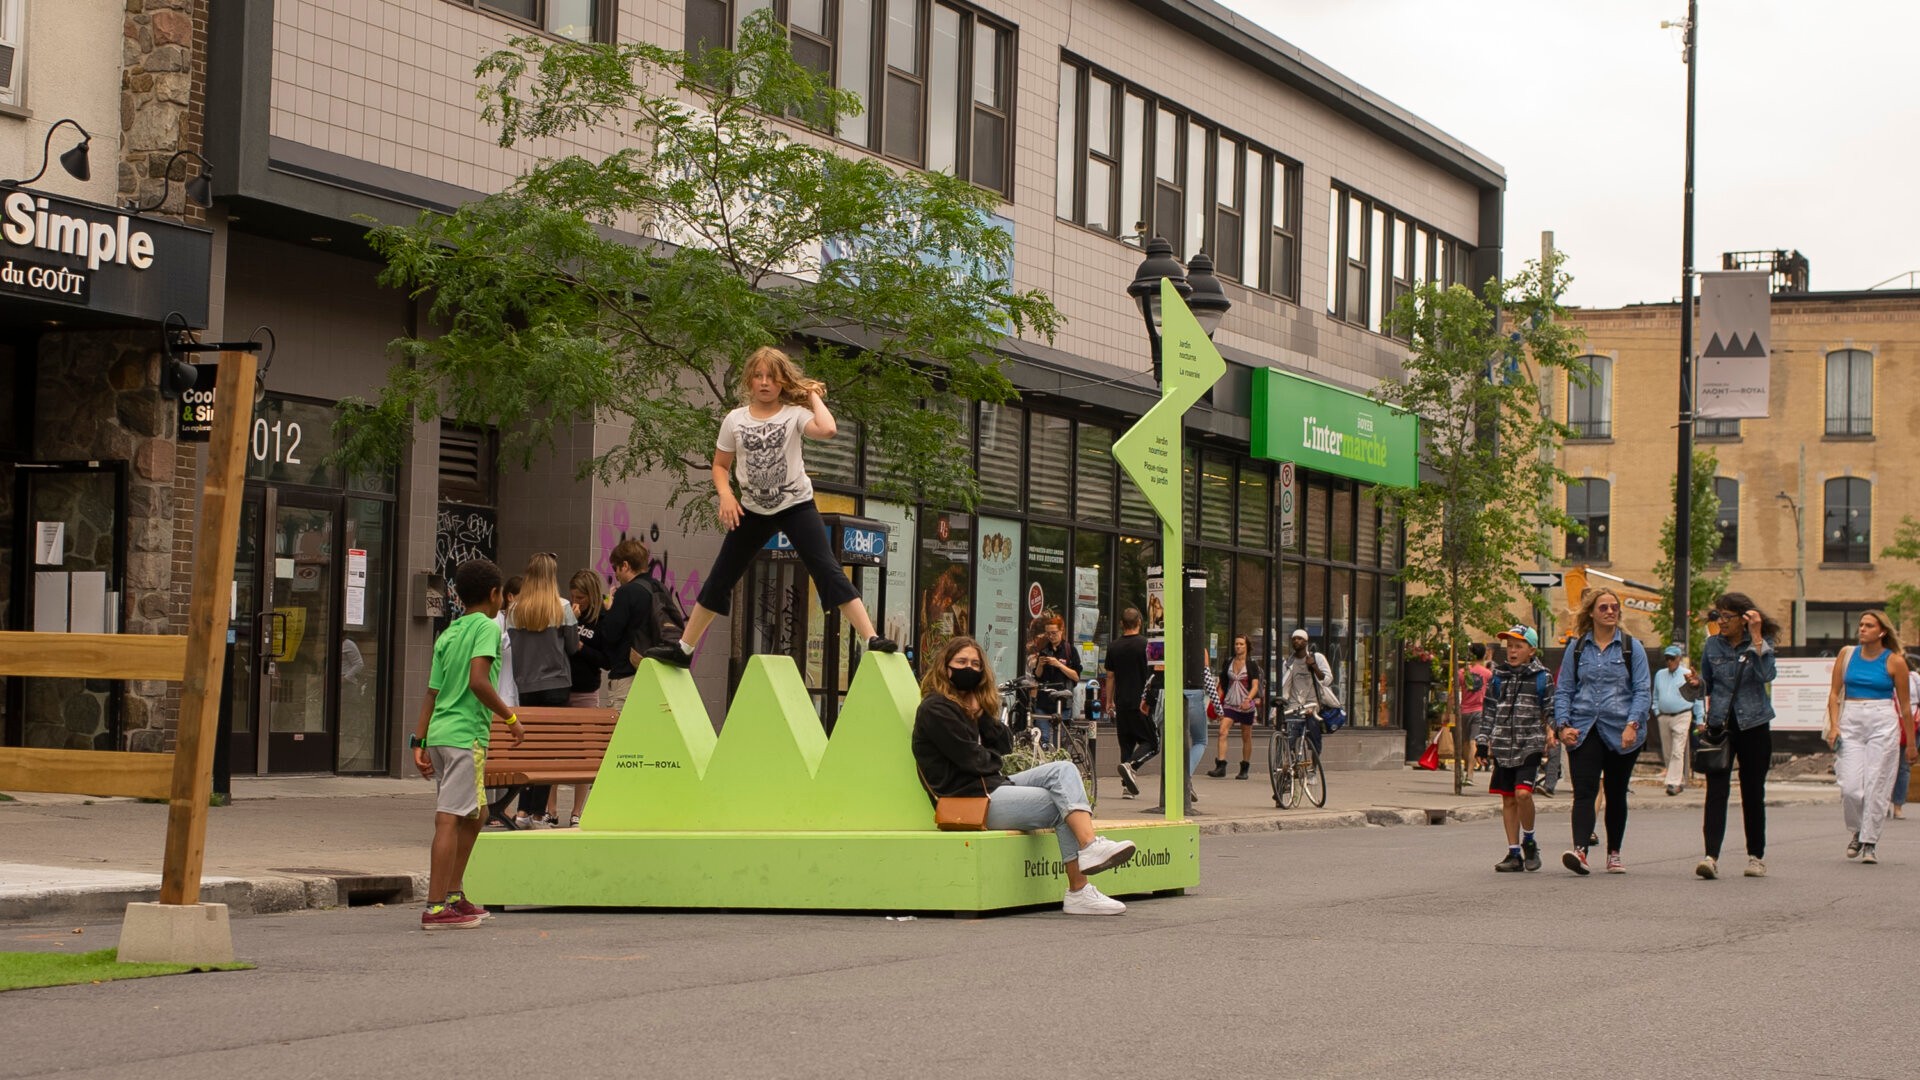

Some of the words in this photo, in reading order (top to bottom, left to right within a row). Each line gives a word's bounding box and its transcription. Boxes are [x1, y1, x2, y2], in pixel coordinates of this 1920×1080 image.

[3, 192, 154, 270] Simple
[1, 261, 24, 285] du
[28, 267, 85, 295] GOÛT
[577, 624, 594, 639] das
[1024, 856, 1049, 878] Petit
